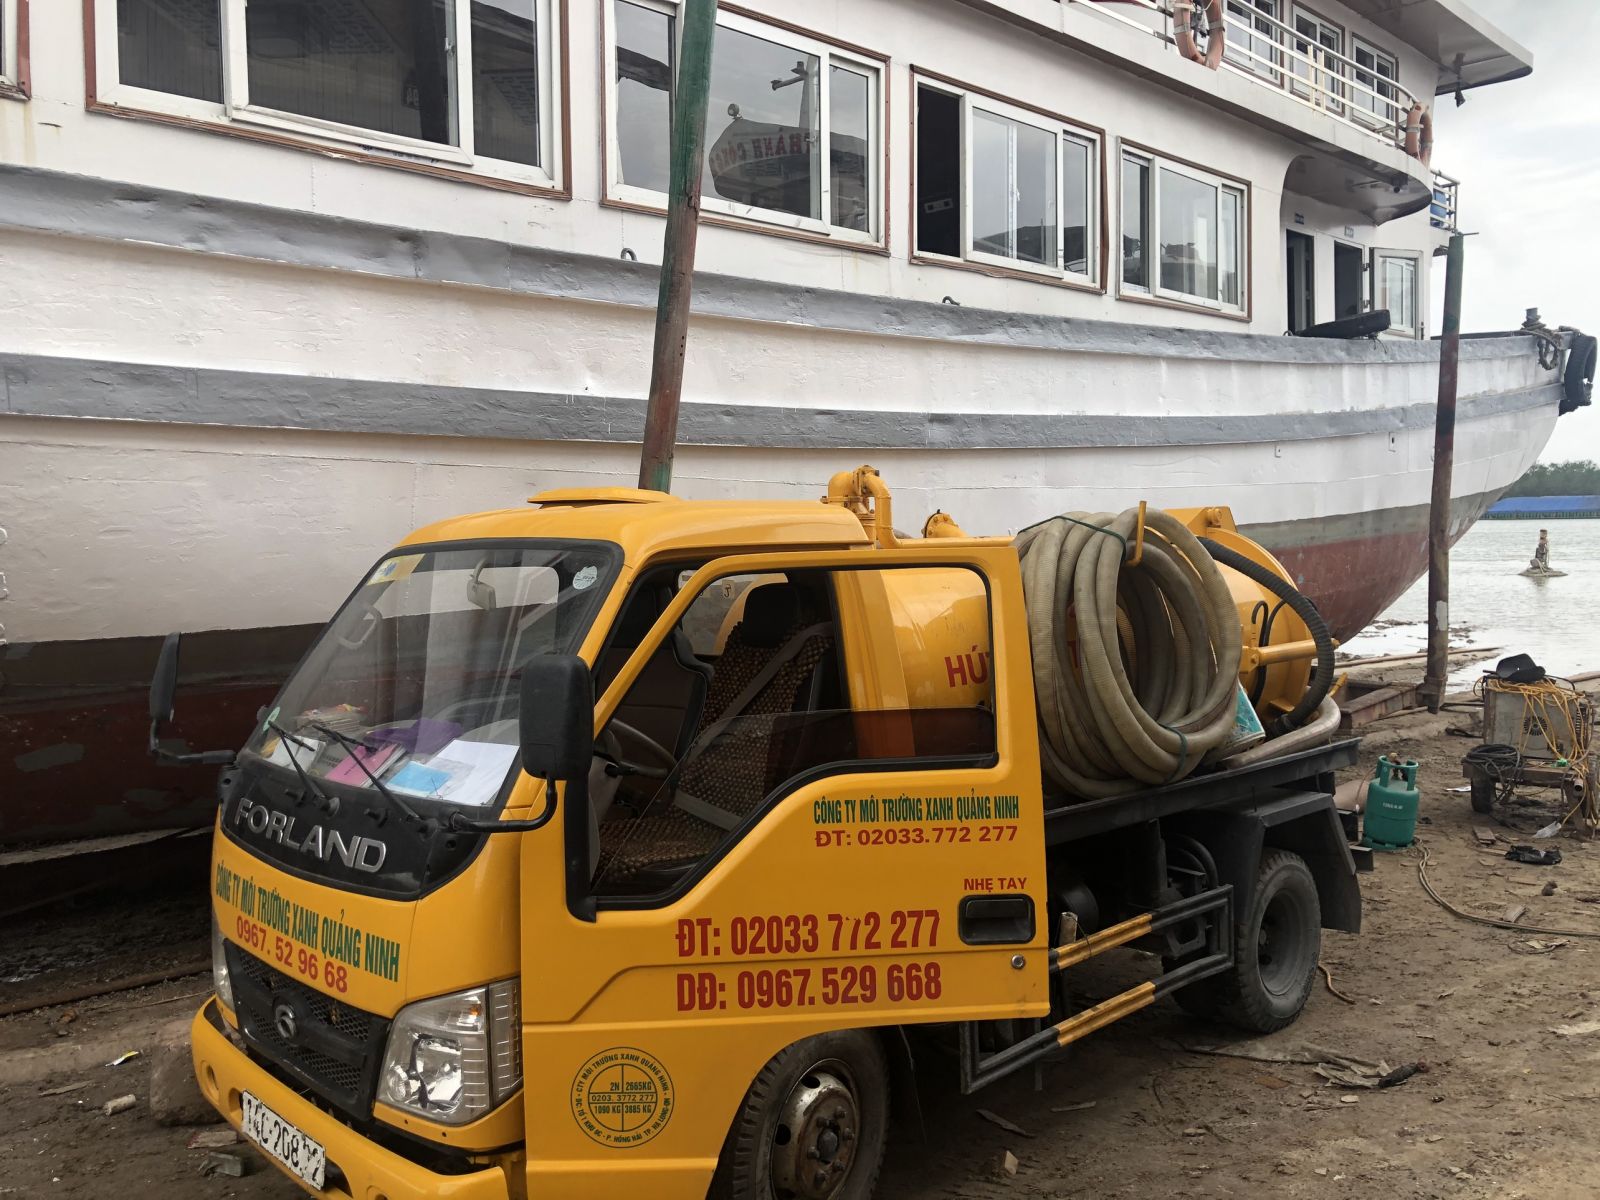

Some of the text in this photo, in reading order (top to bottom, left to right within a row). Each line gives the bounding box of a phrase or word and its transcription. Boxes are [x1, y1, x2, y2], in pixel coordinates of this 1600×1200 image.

[945, 645, 990, 688] HÚ
[814, 788, 1019, 824] CÔNG TY MÔI TRƯỜNG XANH QUẢNG NINH
[234, 797, 387, 873] FORLAND
[814, 825, 1018, 847] ĐT: 02033.772 277
[963, 877, 1028, 893] NHẸ TAY
[215, 860, 401, 983] CÔNG TY MÔI TRƯỜNG XANH QUẢNG NINH
[675, 918, 721, 957] ĐT:
[730, 914, 819, 956] 02033
[890, 909, 941, 949] 277
[298, 948, 319, 981] 96
[324, 960, 348, 994] 68
[676, 972, 727, 1012] DĐ:
[886, 961, 942, 1002] 668
